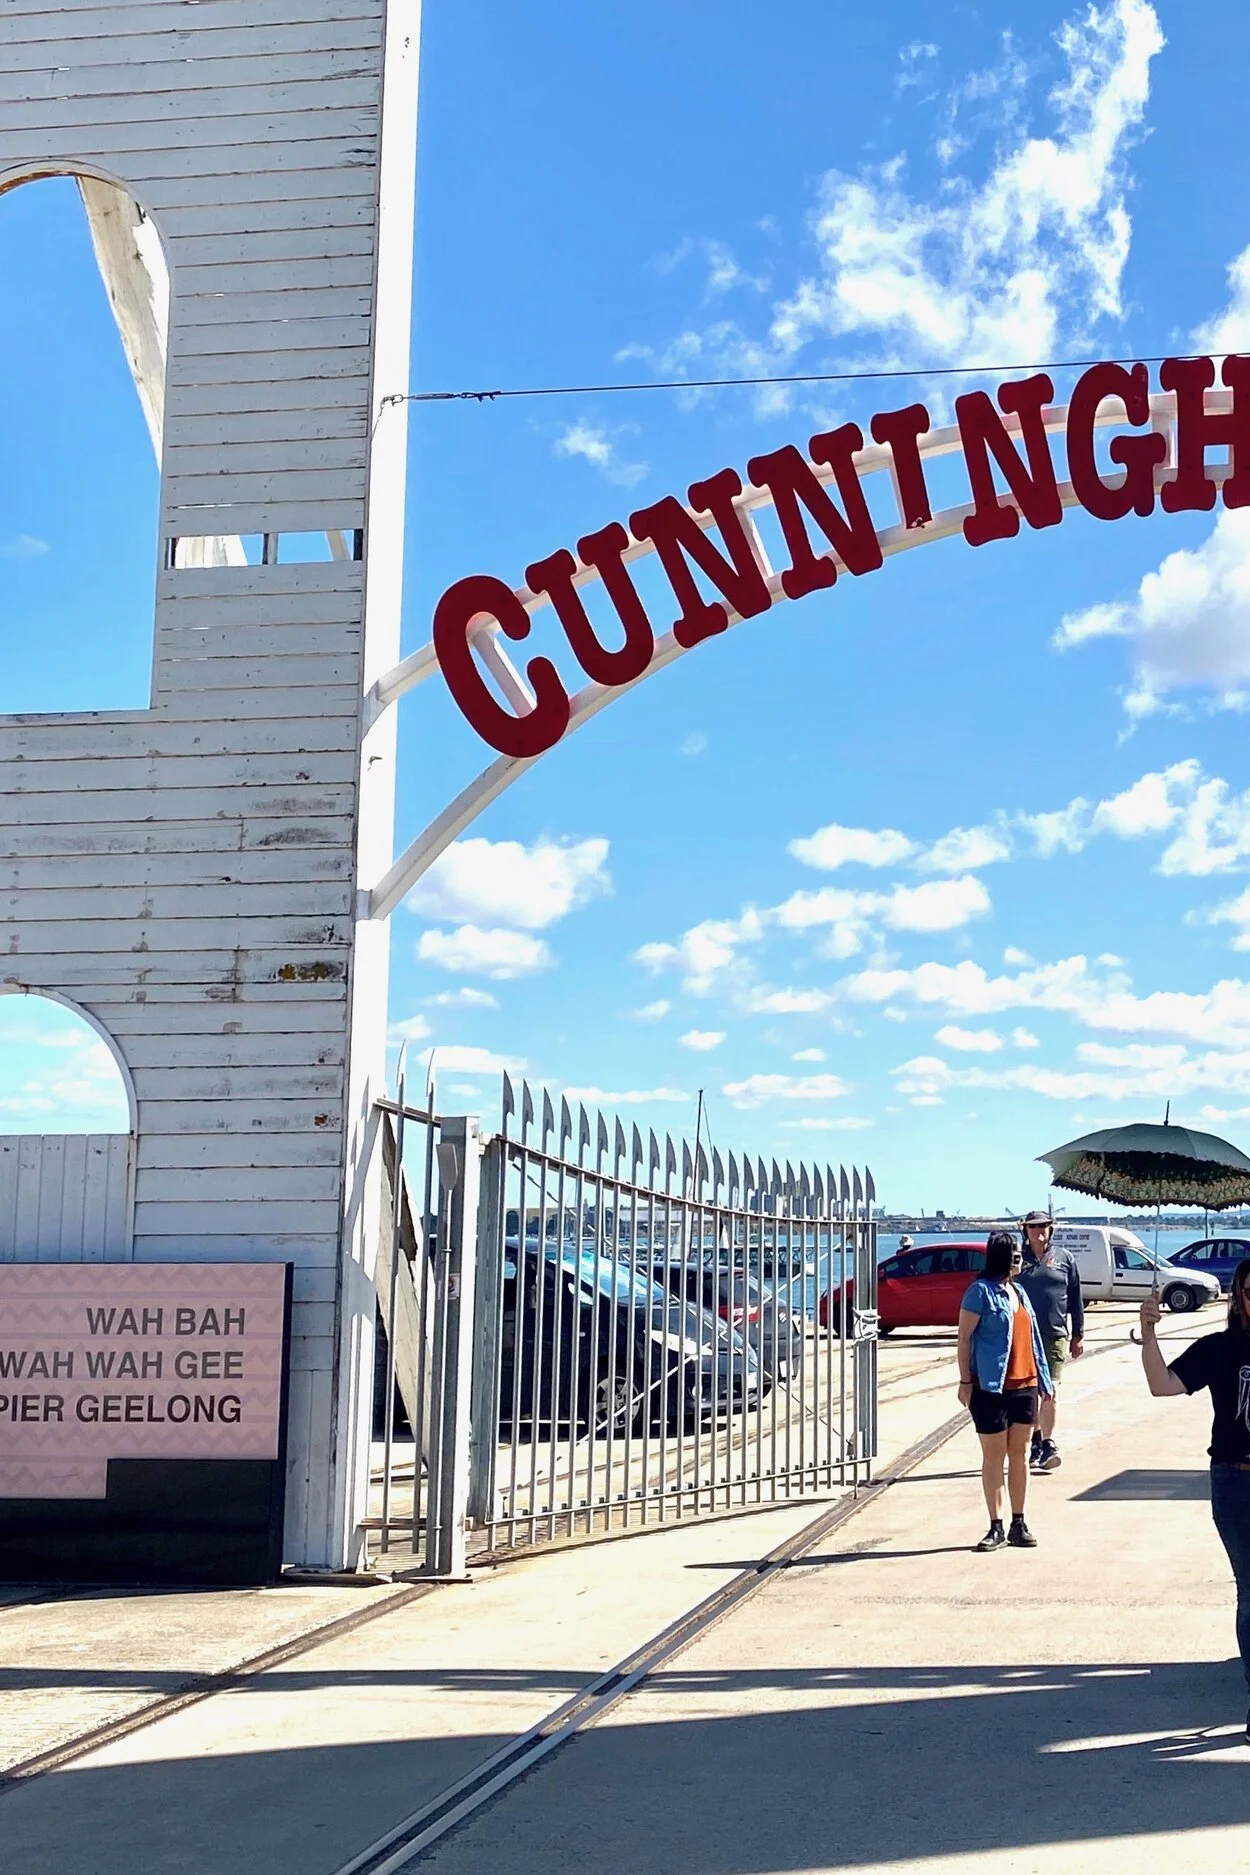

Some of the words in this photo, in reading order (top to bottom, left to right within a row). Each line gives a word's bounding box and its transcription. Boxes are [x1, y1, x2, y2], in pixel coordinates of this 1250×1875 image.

[86, 1308, 163, 1335] WAH
[175, 1308, 246, 1335] BAH
[0, 1351, 74, 1379] WAH
[86, 1351, 163, 1379] WAH
[174, 1351, 244, 1379] GEE
[75, 1394, 242, 1423] GEELONG
